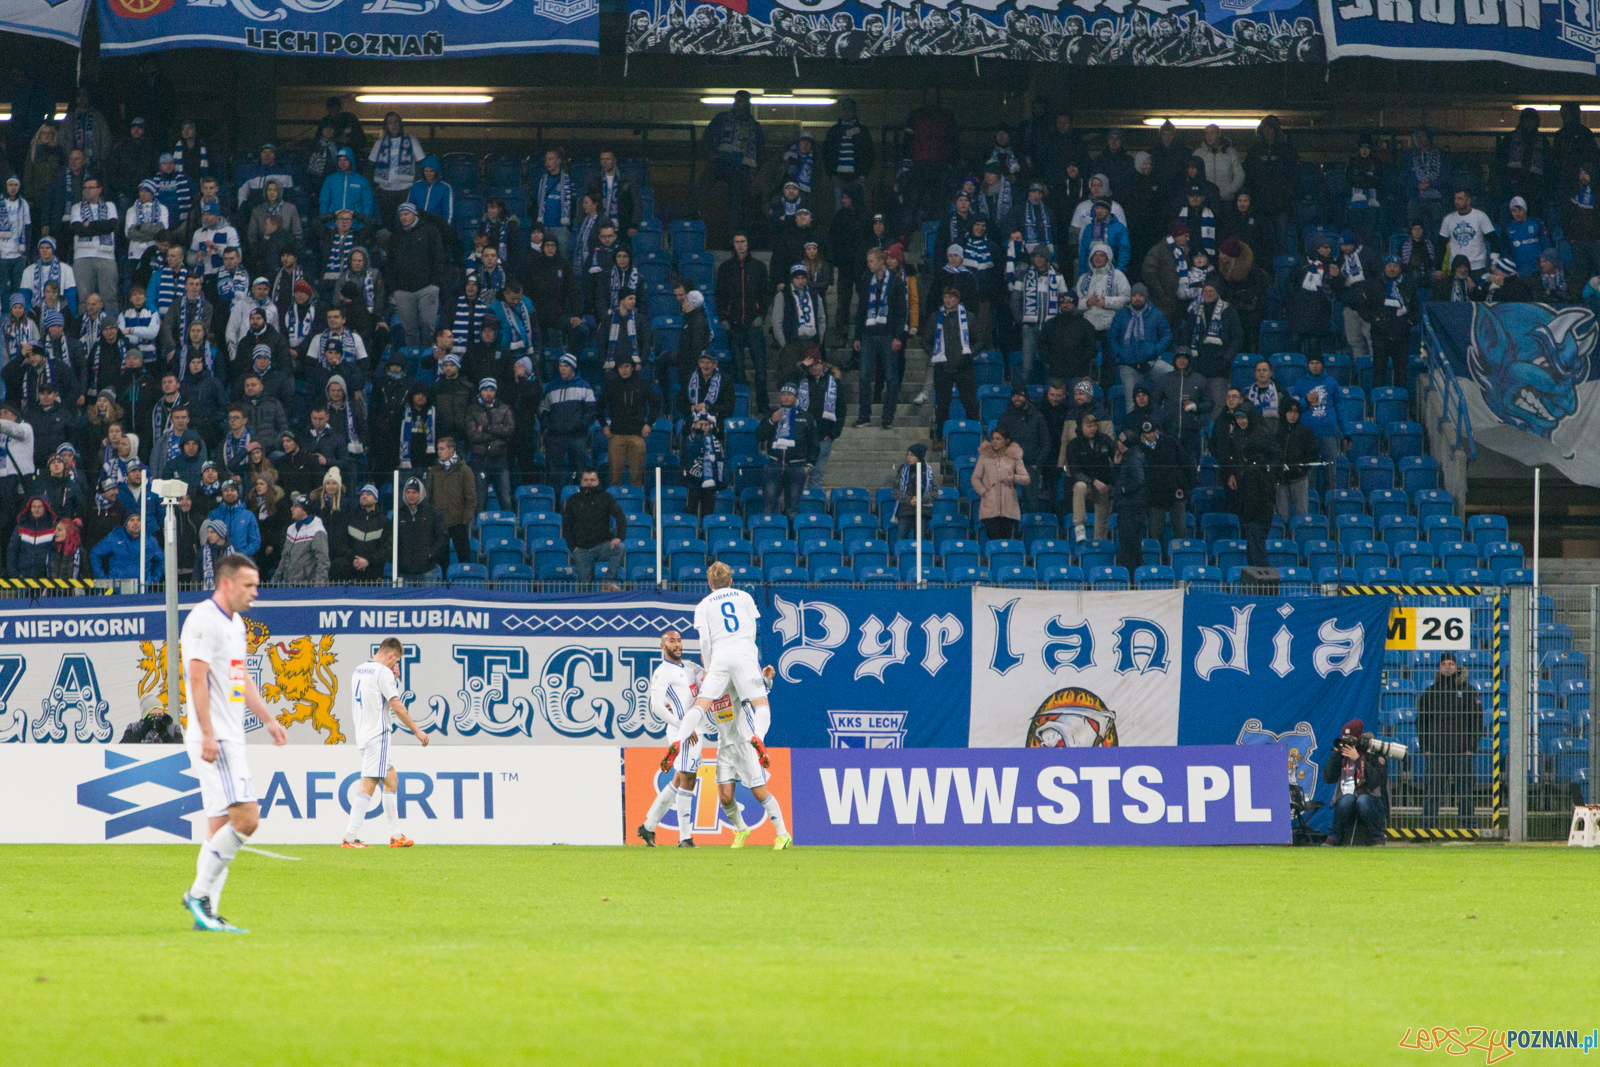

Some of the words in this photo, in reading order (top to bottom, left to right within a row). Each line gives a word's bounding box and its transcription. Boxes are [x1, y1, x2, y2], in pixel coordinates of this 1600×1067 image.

[245, 27, 319, 53] LECH
[709, 590, 740, 602] FURMAN
[15, 617, 146, 638] NIEPOKORNI
[319, 611, 353, 629] MY
[360, 609, 490, 630] NIELUBIANI
[721, 601, 740, 633] 8
[1421, 617, 1465, 642] 26
[355, 679, 364, 710] 4
[838, 716, 863, 729] KKS
[868, 717, 899, 729] LECH
[257, 771, 494, 820] AFORTI
[818, 765, 1273, 825] WWW.STS.PL
